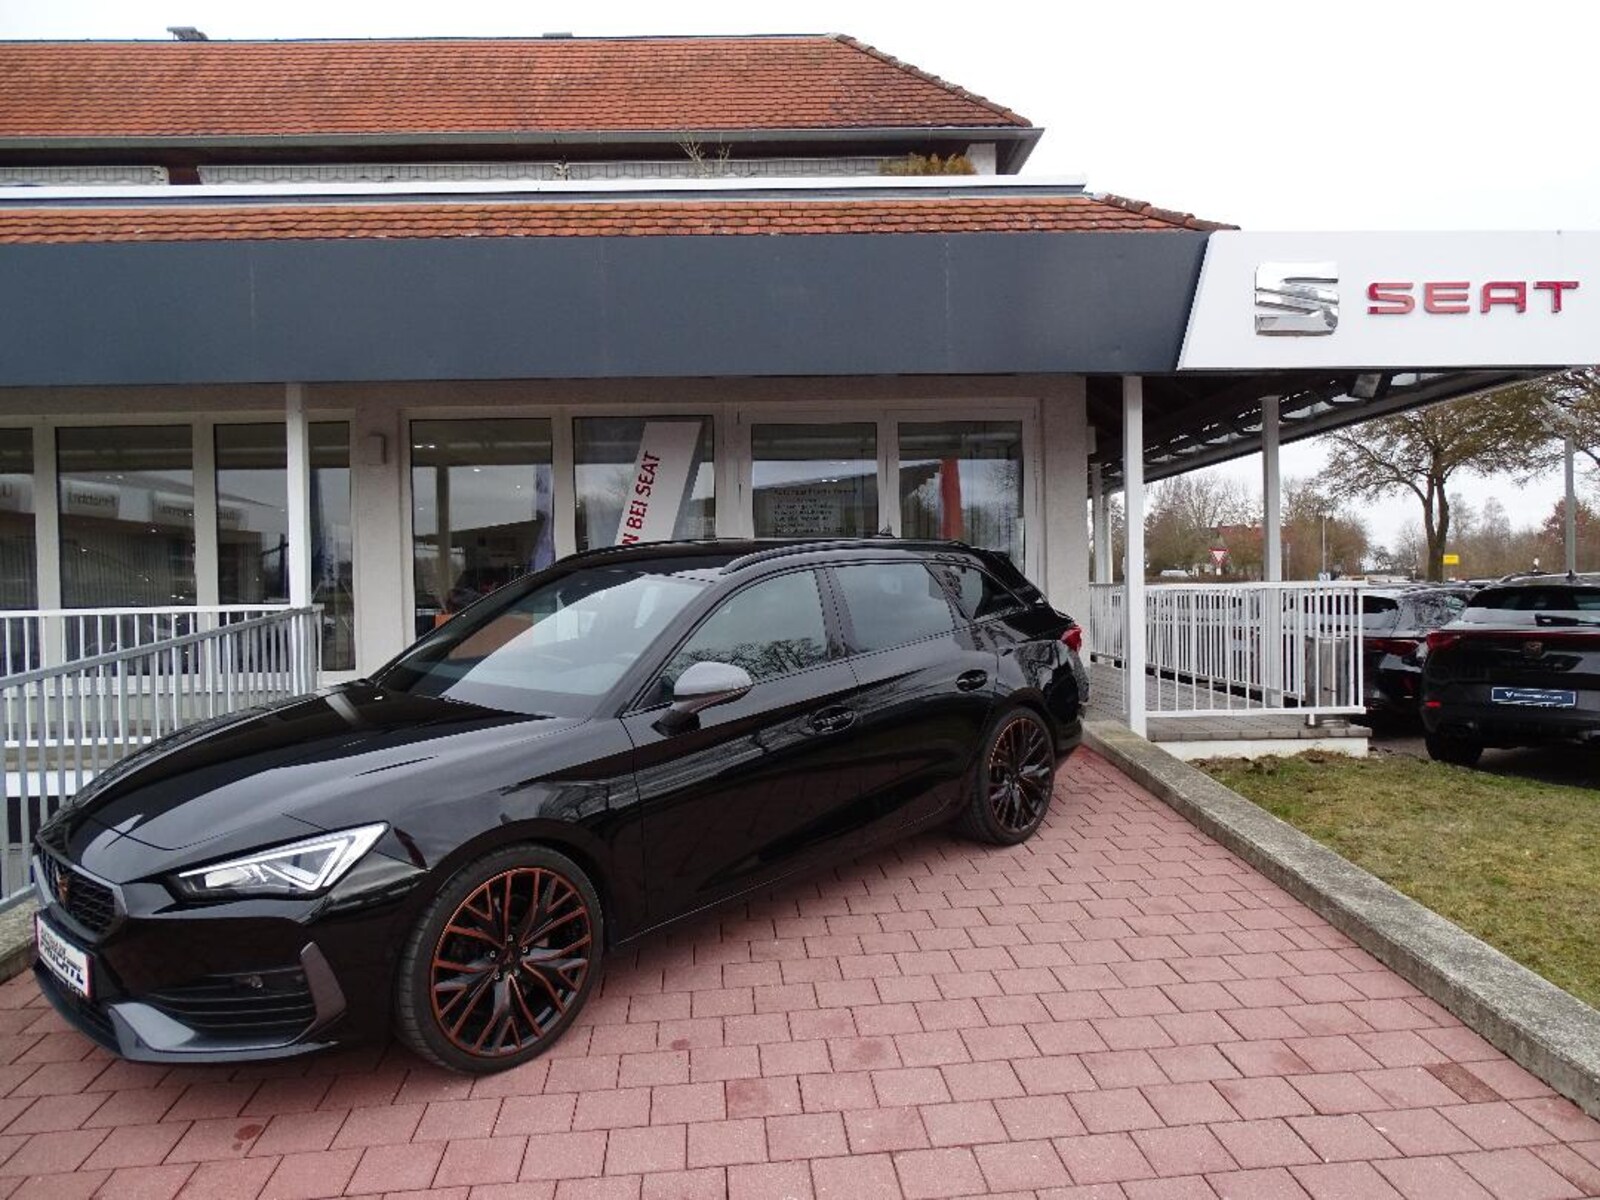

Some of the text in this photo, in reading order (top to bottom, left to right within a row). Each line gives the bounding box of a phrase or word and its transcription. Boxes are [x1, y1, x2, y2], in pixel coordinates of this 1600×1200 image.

[1367, 281, 1580, 315] SEAT
[635, 450, 661, 498] SEAT
[626, 500, 649, 530] BEI
